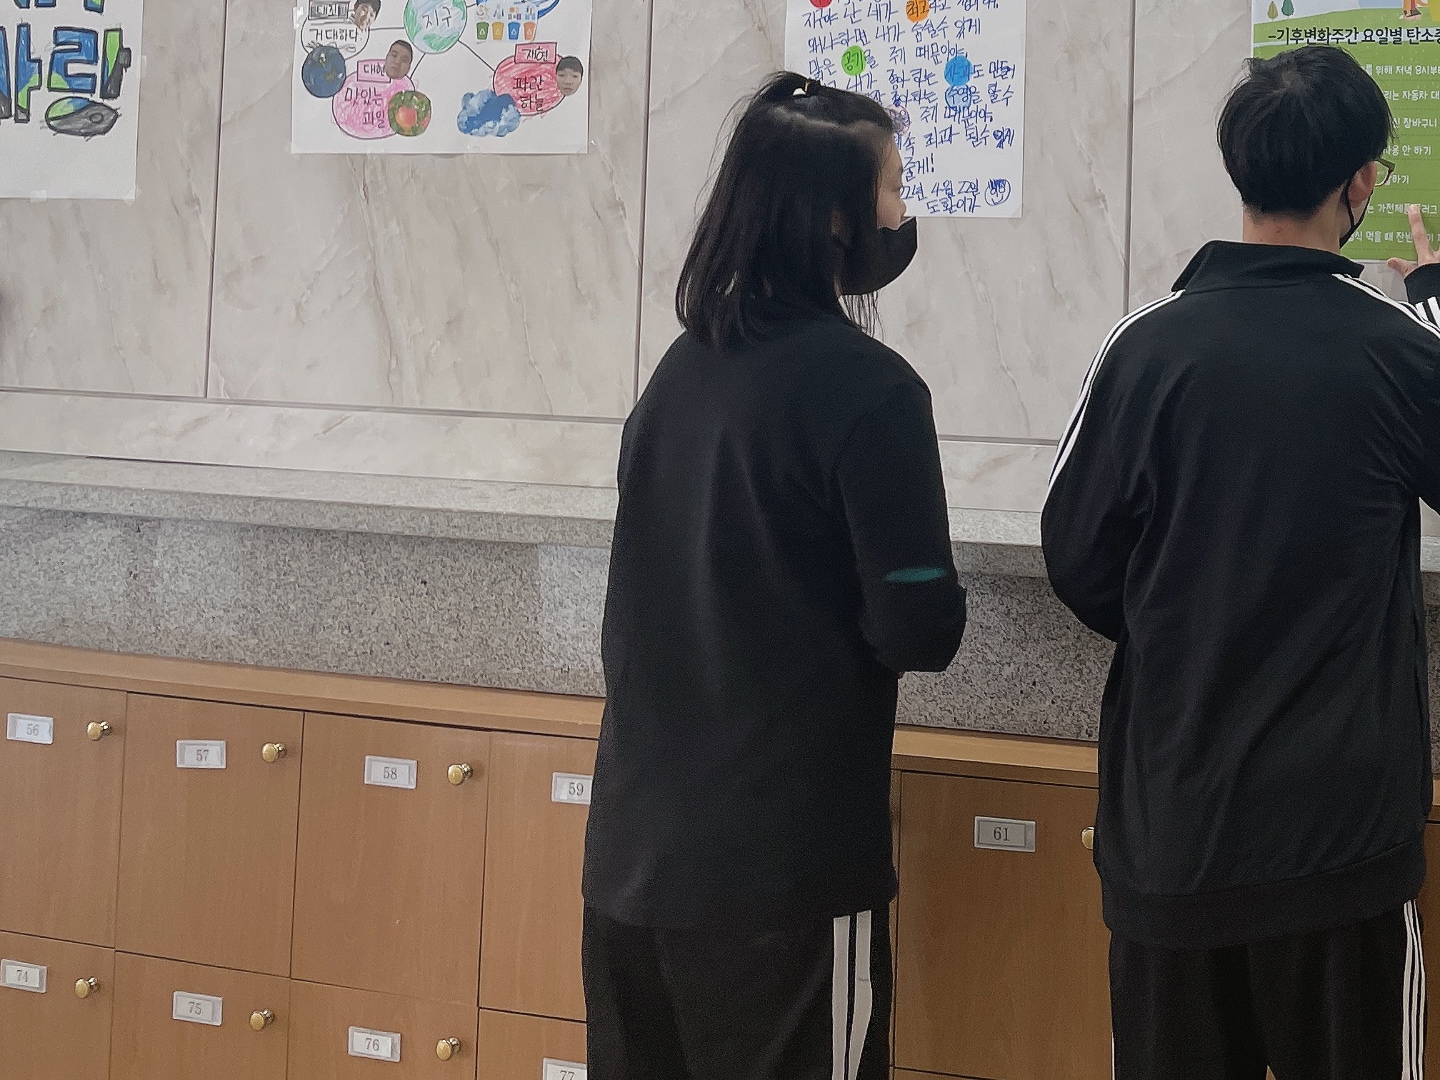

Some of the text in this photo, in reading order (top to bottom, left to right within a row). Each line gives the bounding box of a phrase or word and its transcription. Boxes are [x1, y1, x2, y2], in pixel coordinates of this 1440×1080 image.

[422, 6, 452, 29] 지구
[1363, 28, 1403, 45] 요일별
[1376, 65, 1393, 75] 위해
[1396, 65, 1413, 75] 저녁
[513, 75, 544, 92] 파란
[345, 87, 383, 106] 맛있는
[1402, 90, 1428, 101] 자동차
[520, 94, 544, 112] 하늘
[363, 110, 385, 129] 과일
[1404, 118, 1437, 128] 장바구니
[1402, 145, 1411, 156] 안
[1414, 146, 1432, 156] 하기
[26, 723, 39, 737] 56
[196, 748, 209, 762] 57
[383, 766, 398, 780] 58
[568, 781, 584, 796] 59
[993, 825, 1009, 841] 61
[16, 969, 28, 983] 74
[188, 1001, 202, 1015] 75
[365, 1037, 380, 1051] 76
[560, 1069, 575, 1080] 77
